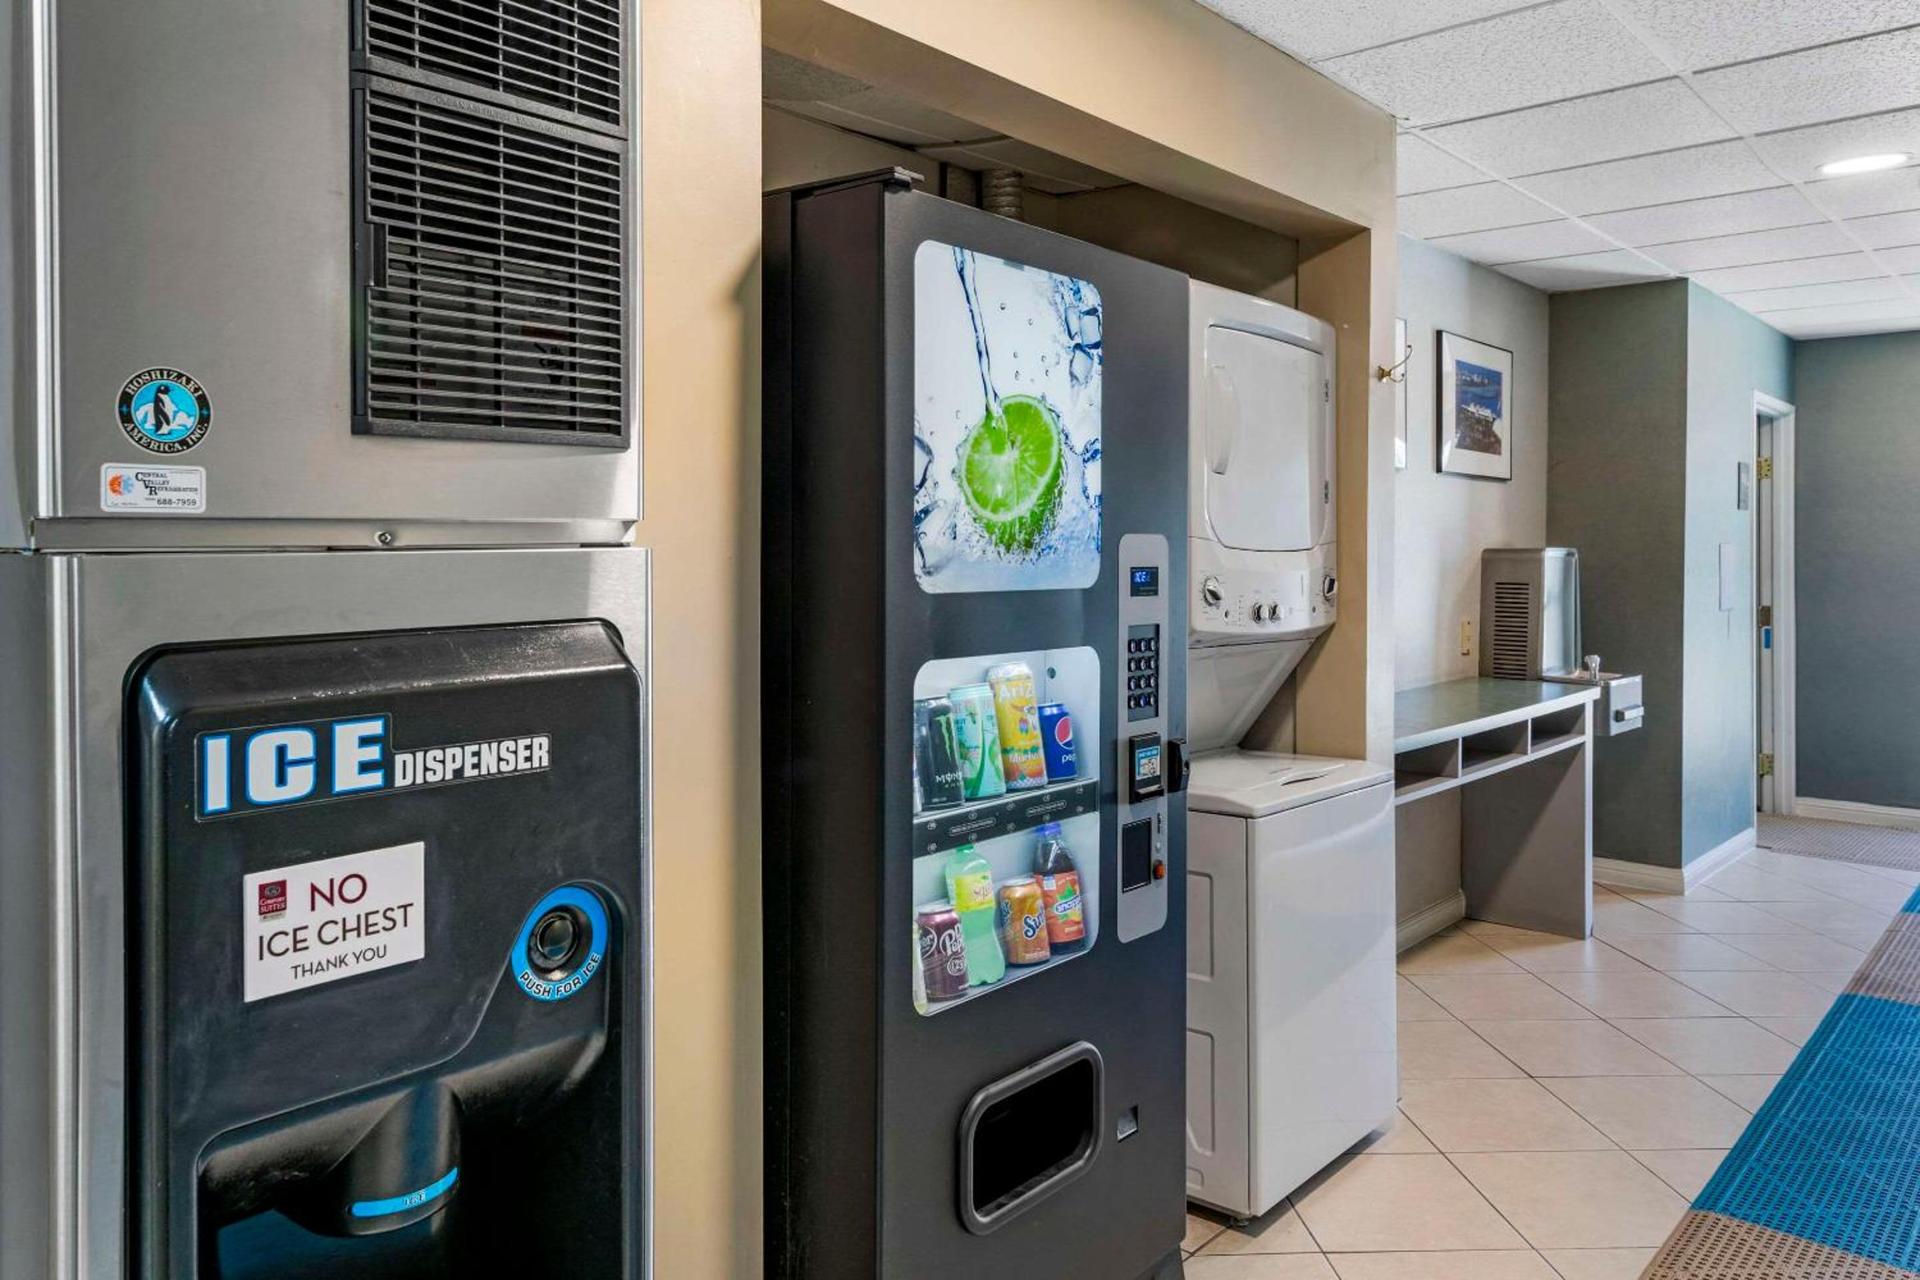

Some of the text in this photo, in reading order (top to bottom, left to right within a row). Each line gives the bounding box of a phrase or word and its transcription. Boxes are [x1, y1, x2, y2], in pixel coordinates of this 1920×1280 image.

[125, 370, 204, 398] HOSHIZAKI
[203, 716, 550, 816] ICE DISPENSER
[310, 873, 368, 912] NO
[258, 902, 415, 961] ICE CHEST
[291, 944, 388, 981] THANK YOU
[520, 952, 602, 998] PUSH FOR ICE
